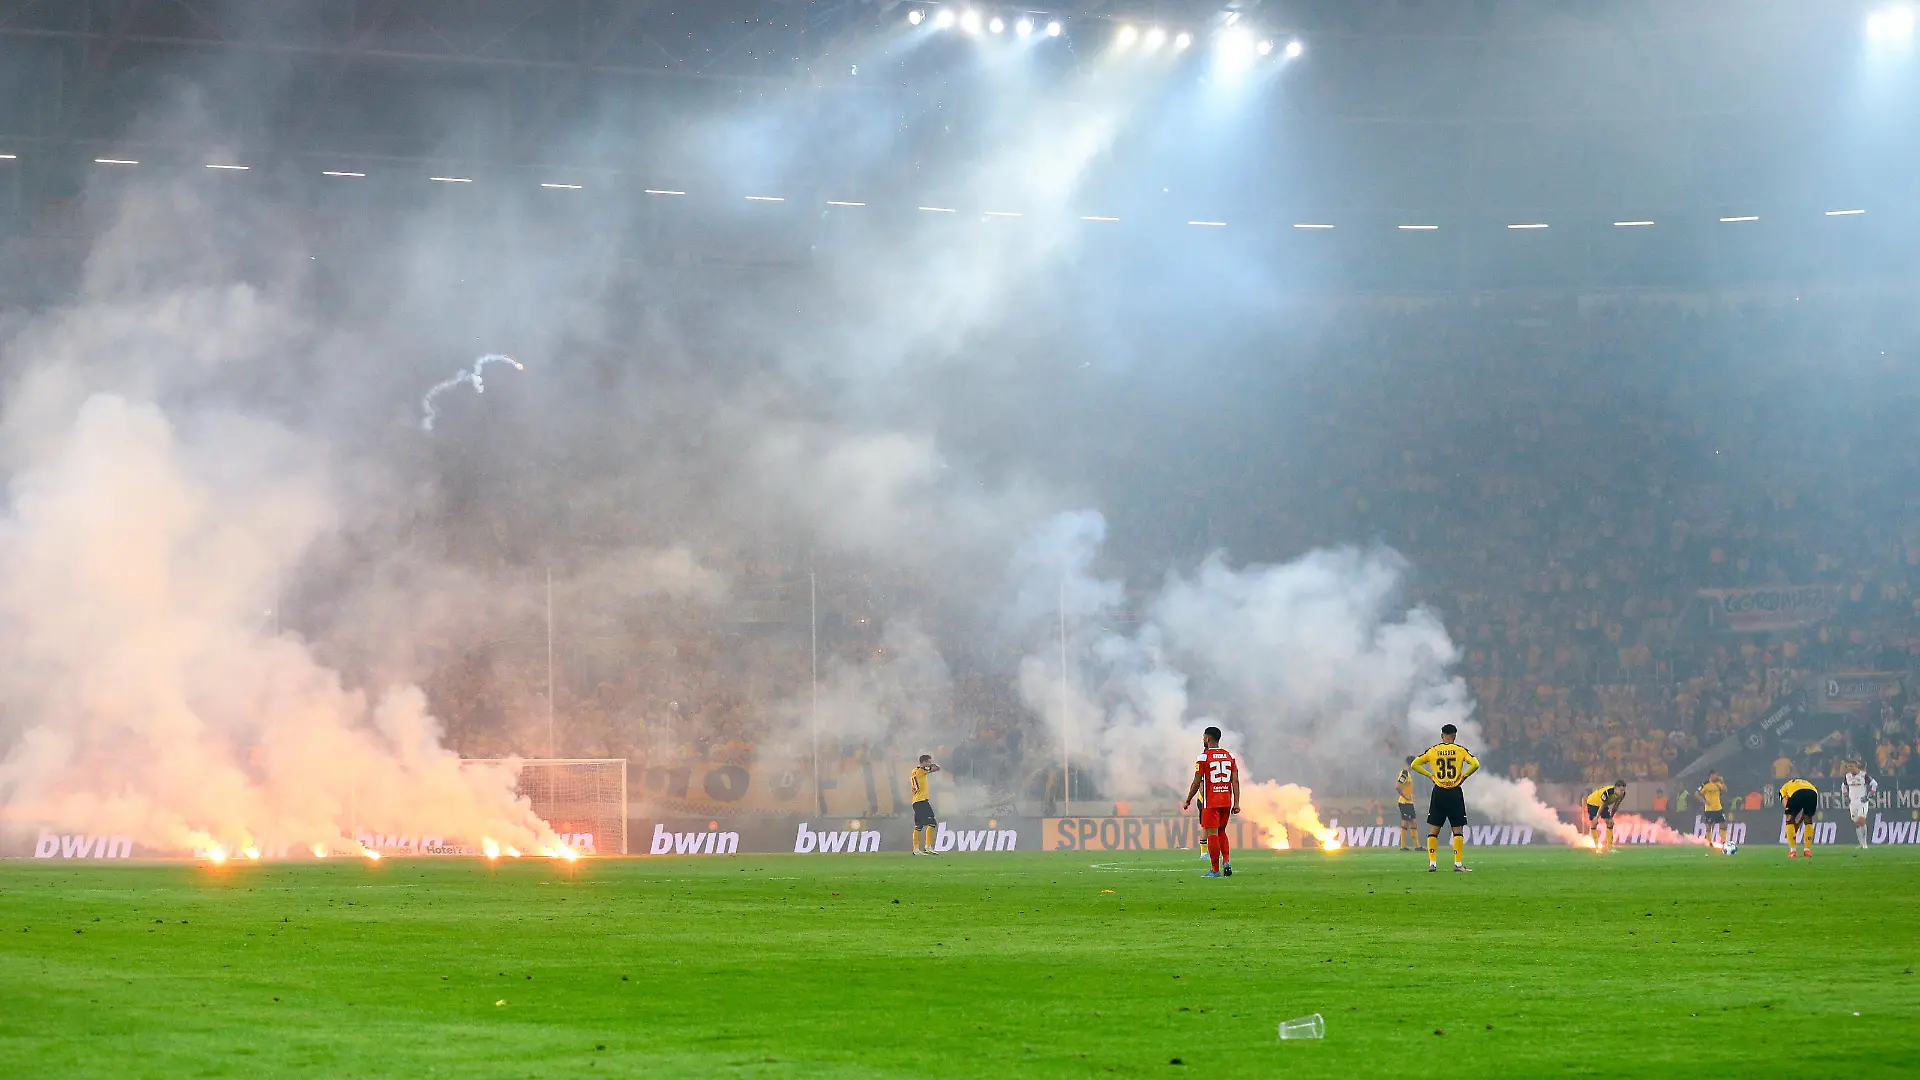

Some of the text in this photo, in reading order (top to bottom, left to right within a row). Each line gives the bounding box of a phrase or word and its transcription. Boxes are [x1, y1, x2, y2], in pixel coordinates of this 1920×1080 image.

[1209, 761, 1232, 784] 25
[1436, 757, 1457, 780] 35
[34, 827, 133, 858] bwin
[650, 820, 740, 855] bwin
[794, 819, 881, 853] bwin
[933, 818, 1017, 852] bwin
[1329, 817, 1401, 848] bwin
